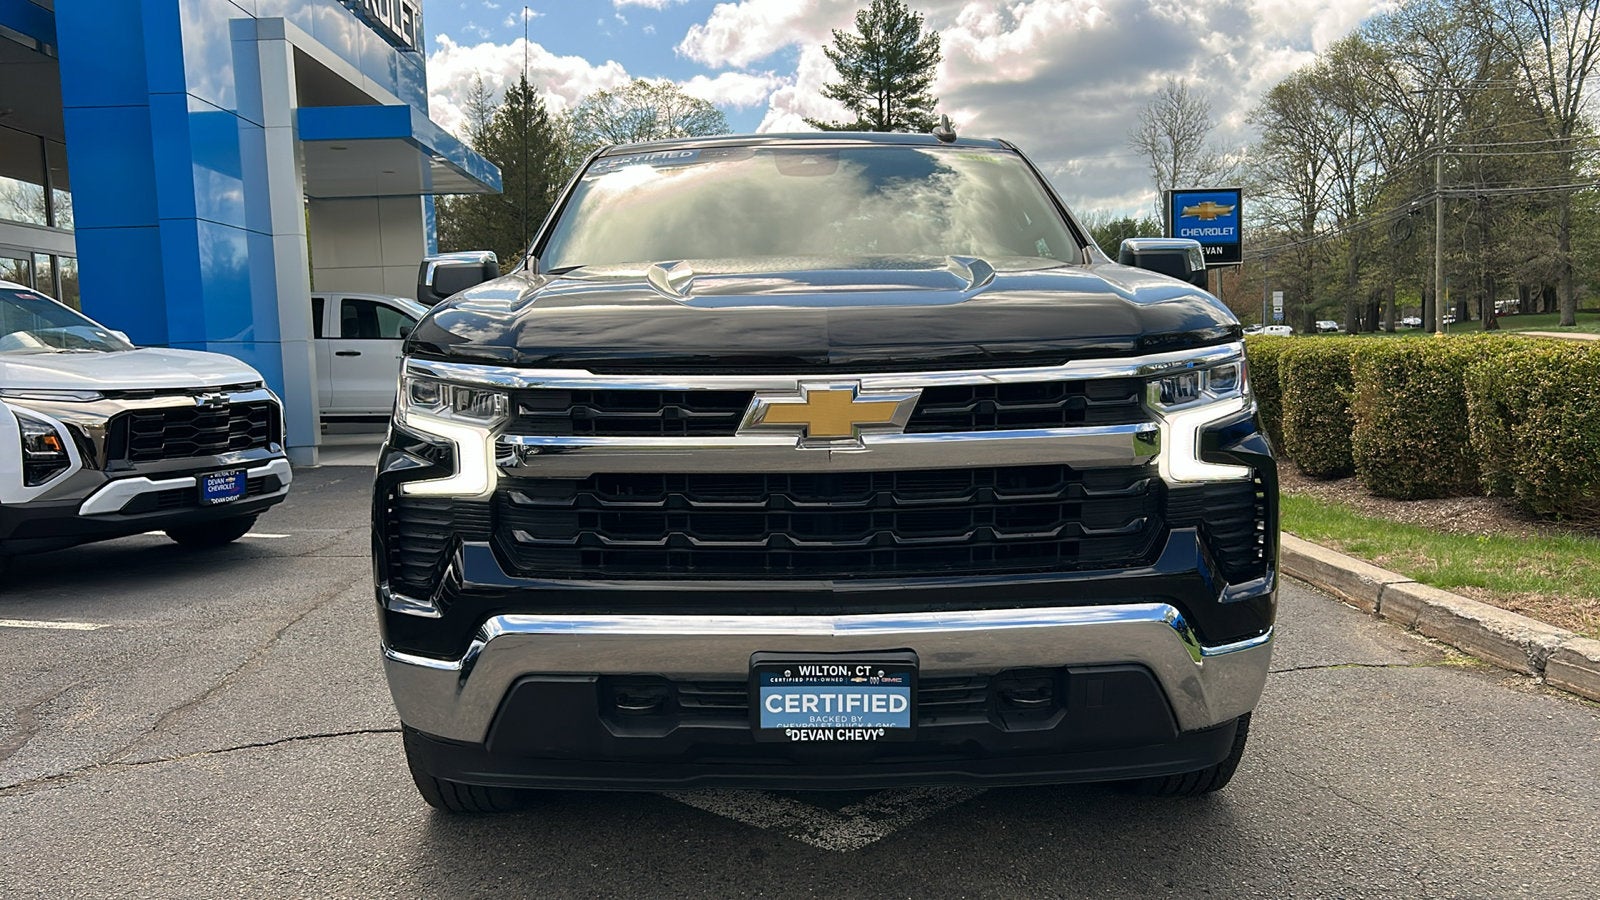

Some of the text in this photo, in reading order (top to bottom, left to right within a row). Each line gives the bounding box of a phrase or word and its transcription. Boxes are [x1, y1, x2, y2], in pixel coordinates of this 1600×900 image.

[1181, 227, 1234, 237] CHEVROLET
[1202, 246, 1223, 255] EVAN
[208, 483, 235, 492] CHEVROLET
[799, 666, 872, 676] WILTON, CT
[765, 694, 908, 713] CERTIFIED
[809, 715, 863, 723] BACKED BY
